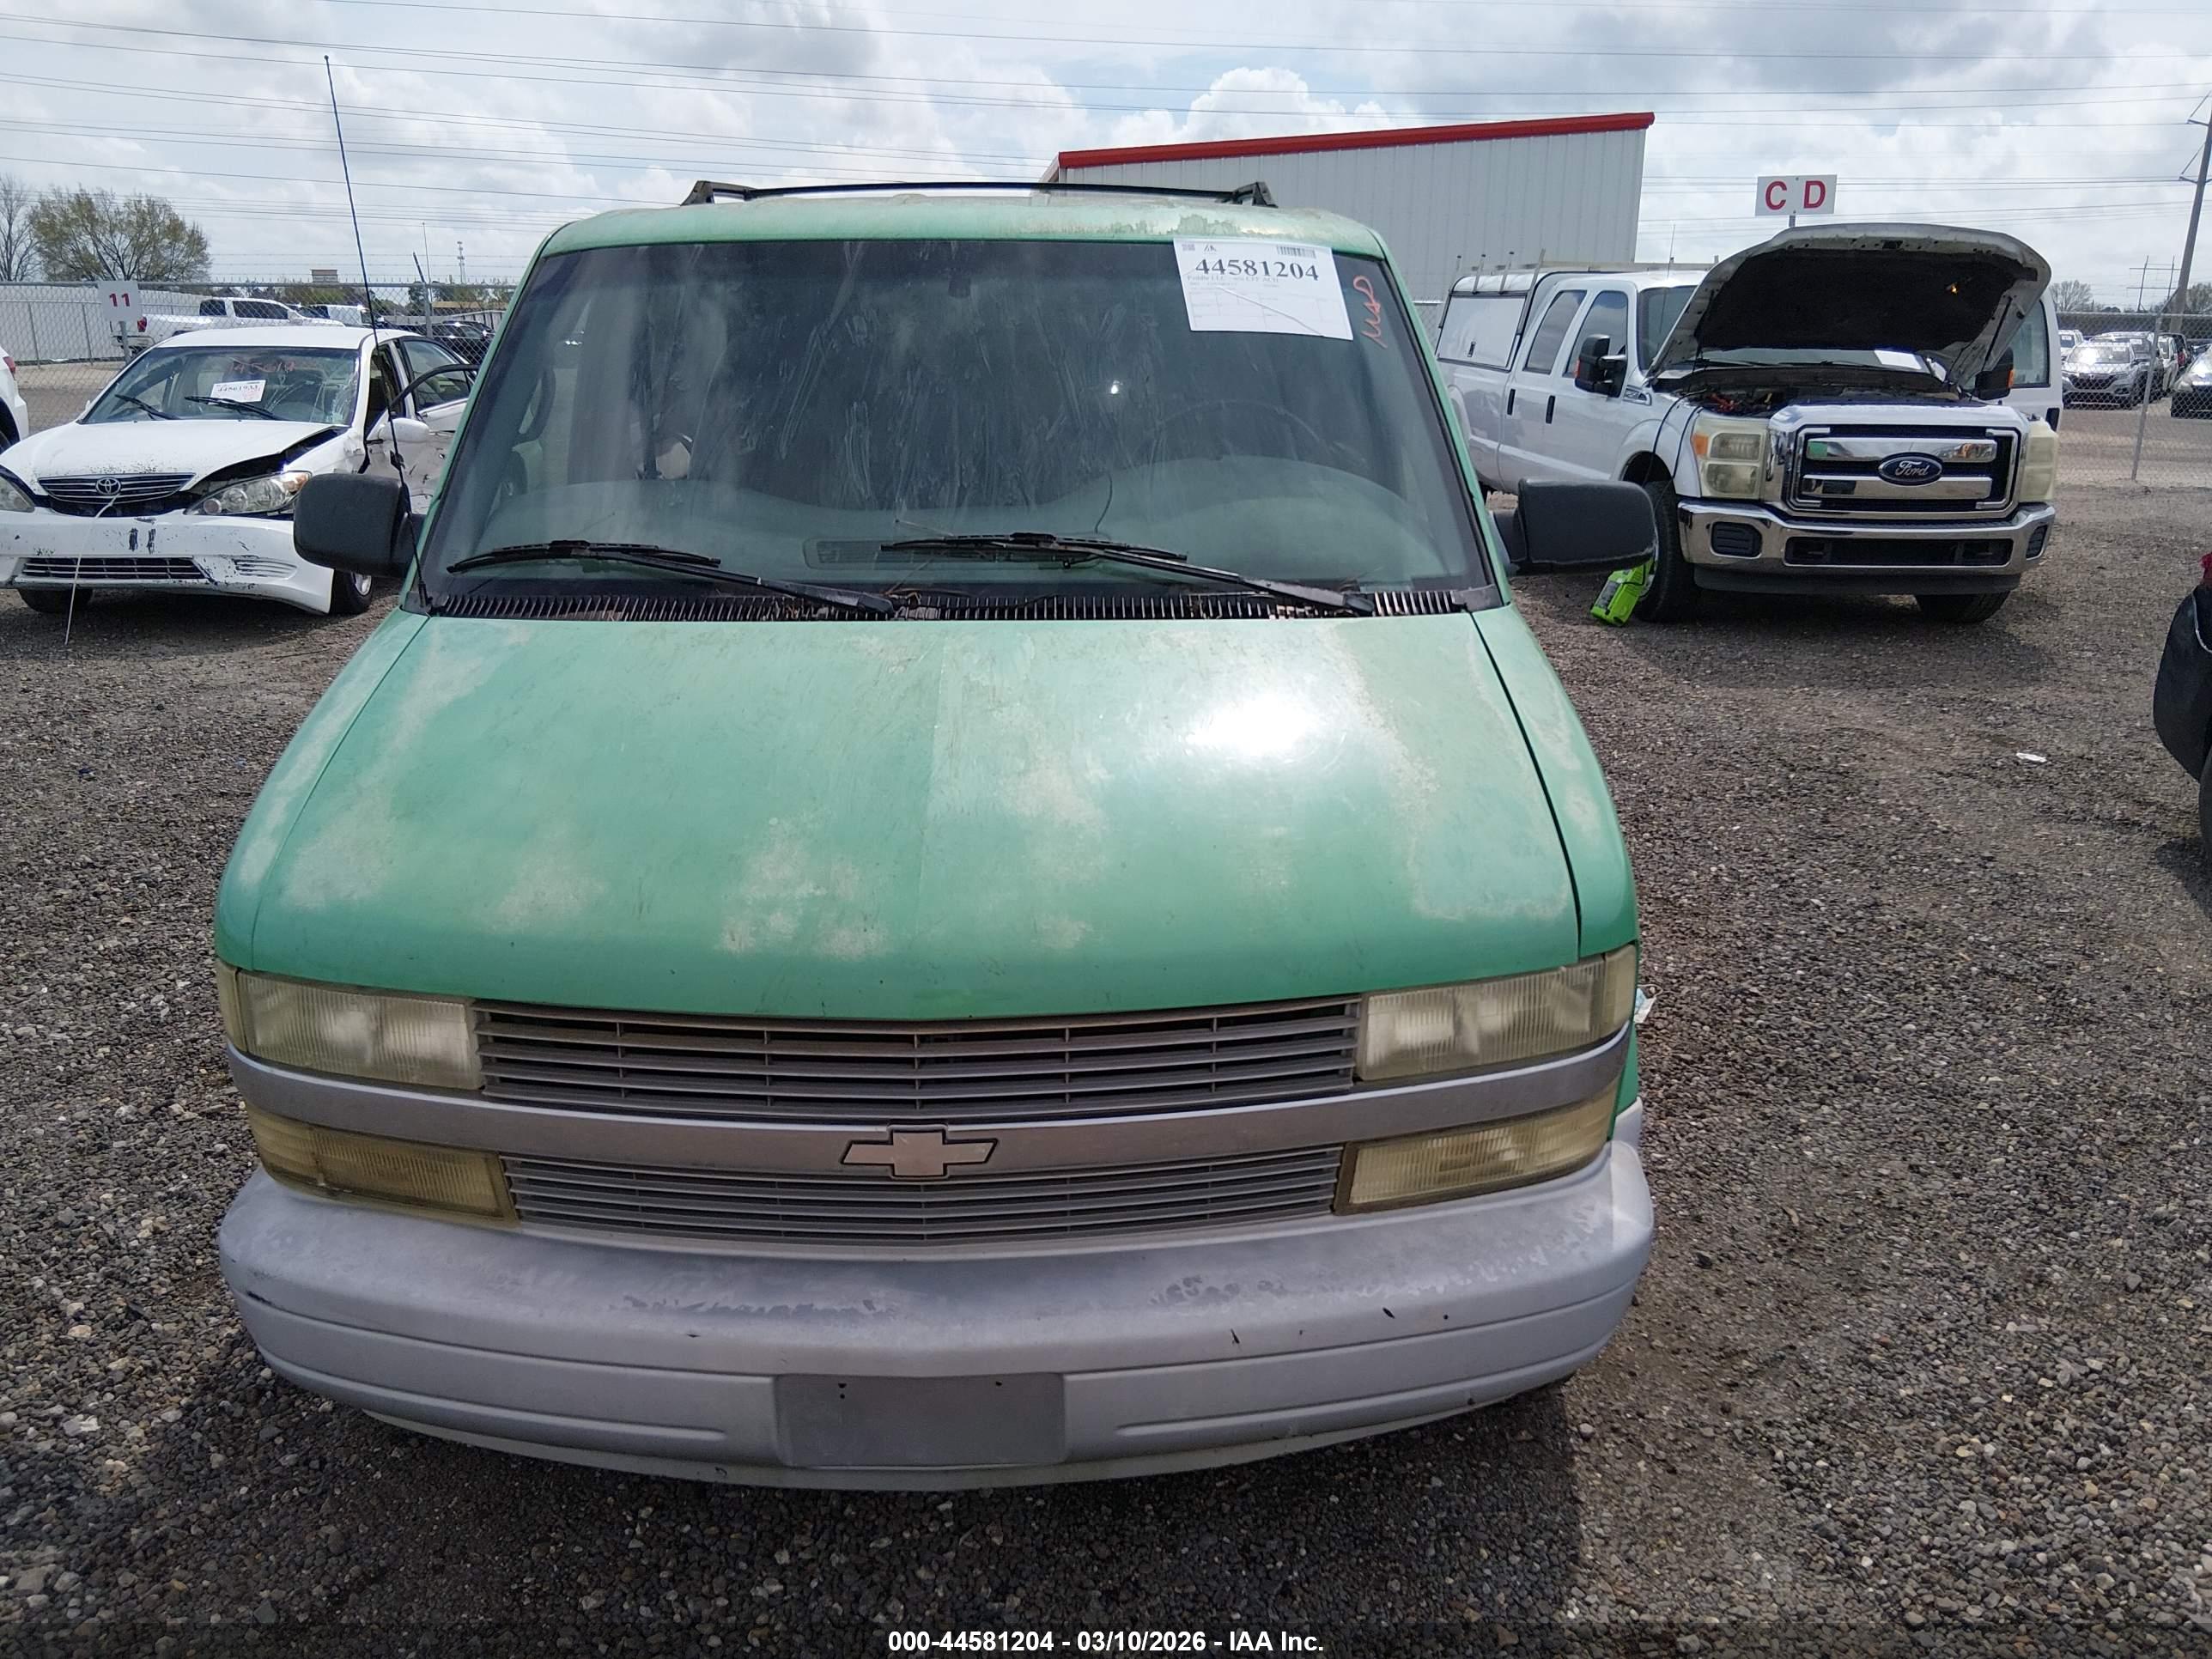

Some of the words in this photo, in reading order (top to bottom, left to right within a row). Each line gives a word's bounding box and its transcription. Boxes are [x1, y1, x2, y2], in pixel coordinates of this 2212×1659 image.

[1765, 180, 1787, 210] C
[1803, 180, 1826, 209] D
[1194, 258, 1319, 281] 44581204
[109, 293, 131, 307] 11
[1895, 460, 1930, 477] Ford
